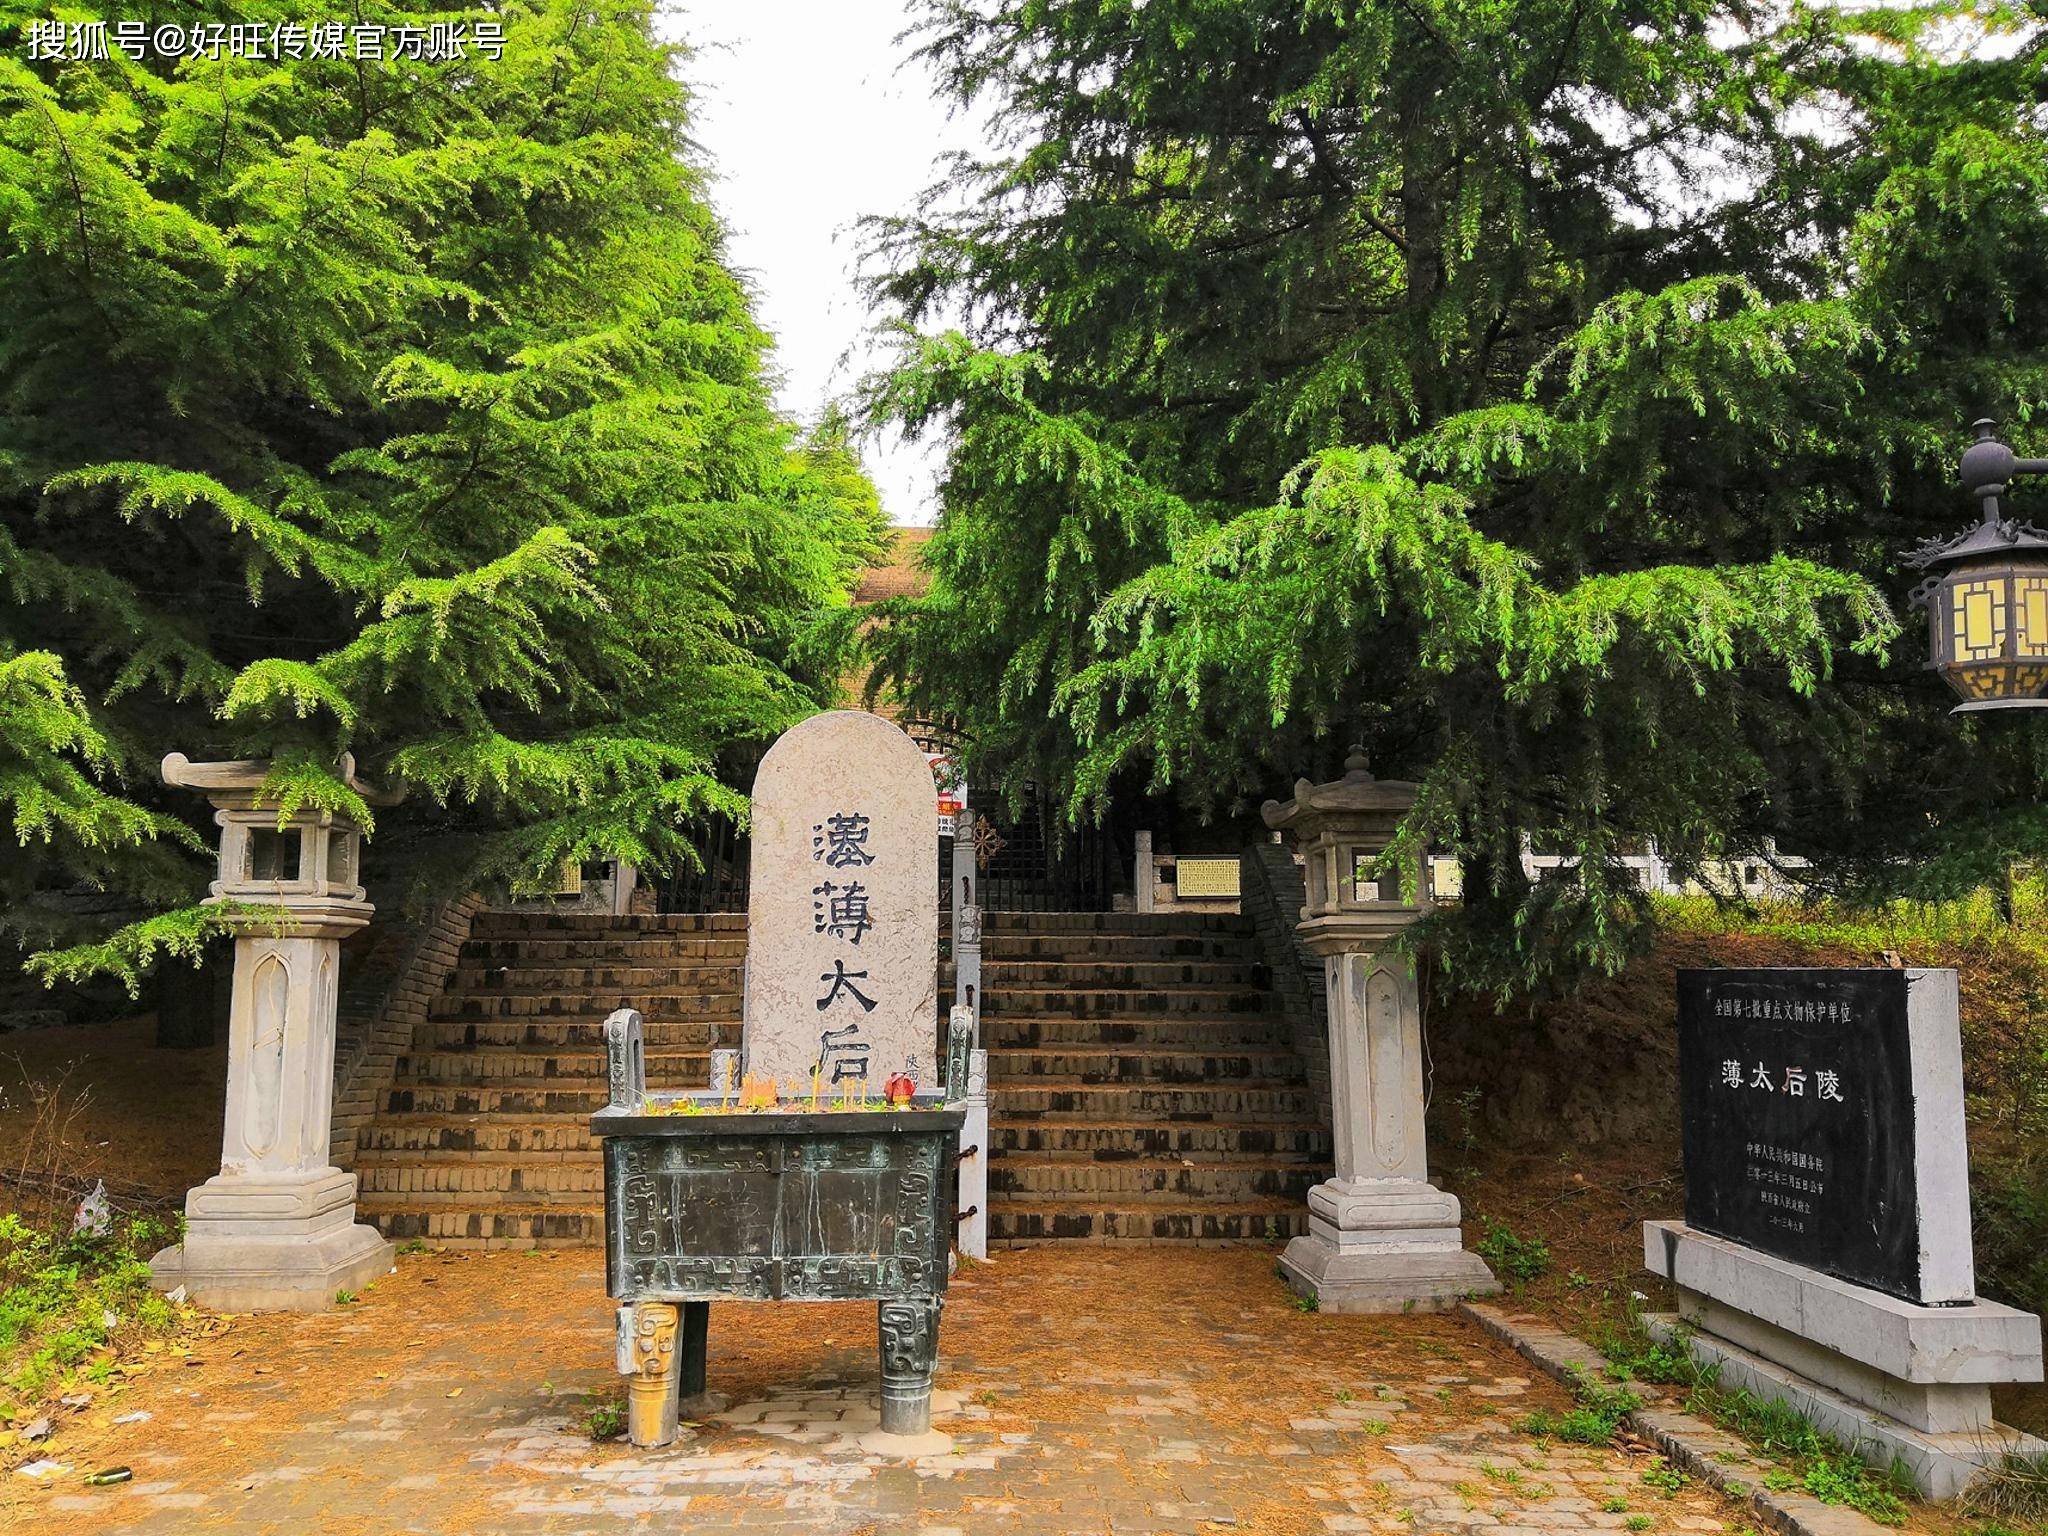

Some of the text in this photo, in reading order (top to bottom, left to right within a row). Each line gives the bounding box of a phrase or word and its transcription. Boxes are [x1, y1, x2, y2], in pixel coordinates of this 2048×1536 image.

[1714, 998, 1853, 1024] 全国第七批重点文物保护单位
[1721, 1058, 1844, 1103] 薄太后陵
